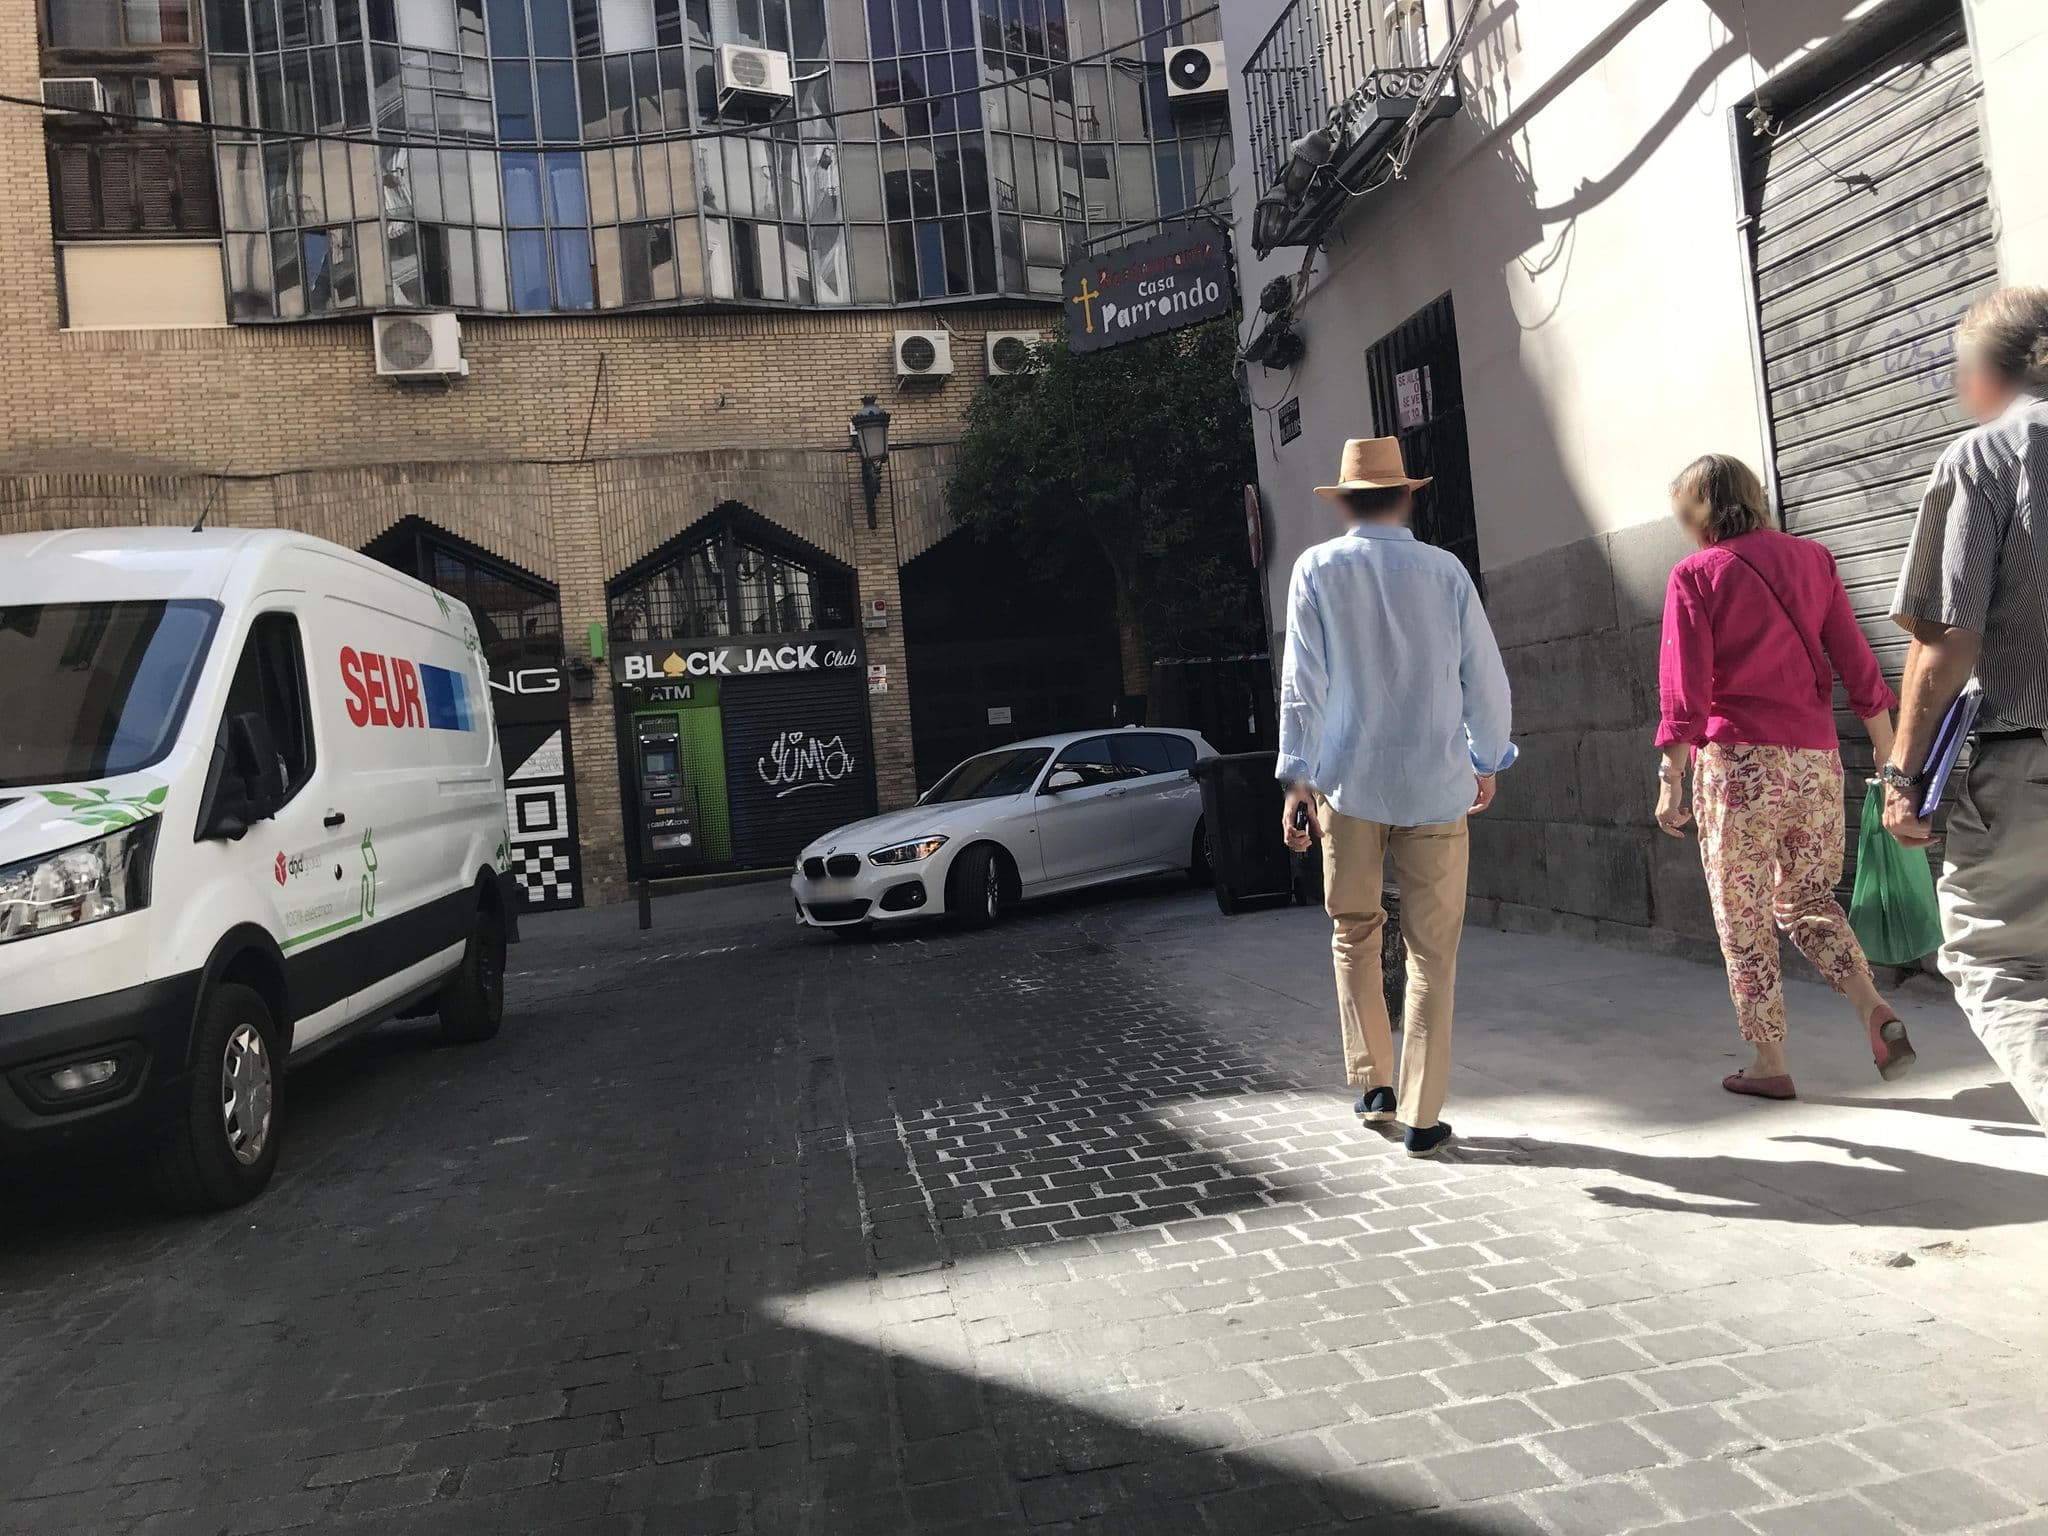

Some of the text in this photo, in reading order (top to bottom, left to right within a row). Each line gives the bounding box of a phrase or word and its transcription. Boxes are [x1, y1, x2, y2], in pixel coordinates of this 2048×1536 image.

[1138, 275, 1174, 297] Casa
[1101, 277, 1220, 334] Parrondo
[738, 645, 820, 673] JACK
[823, 648, 857, 668] Club
[340, 645, 425, 728] SEUR
[650, 684, 691, 701] ATM
